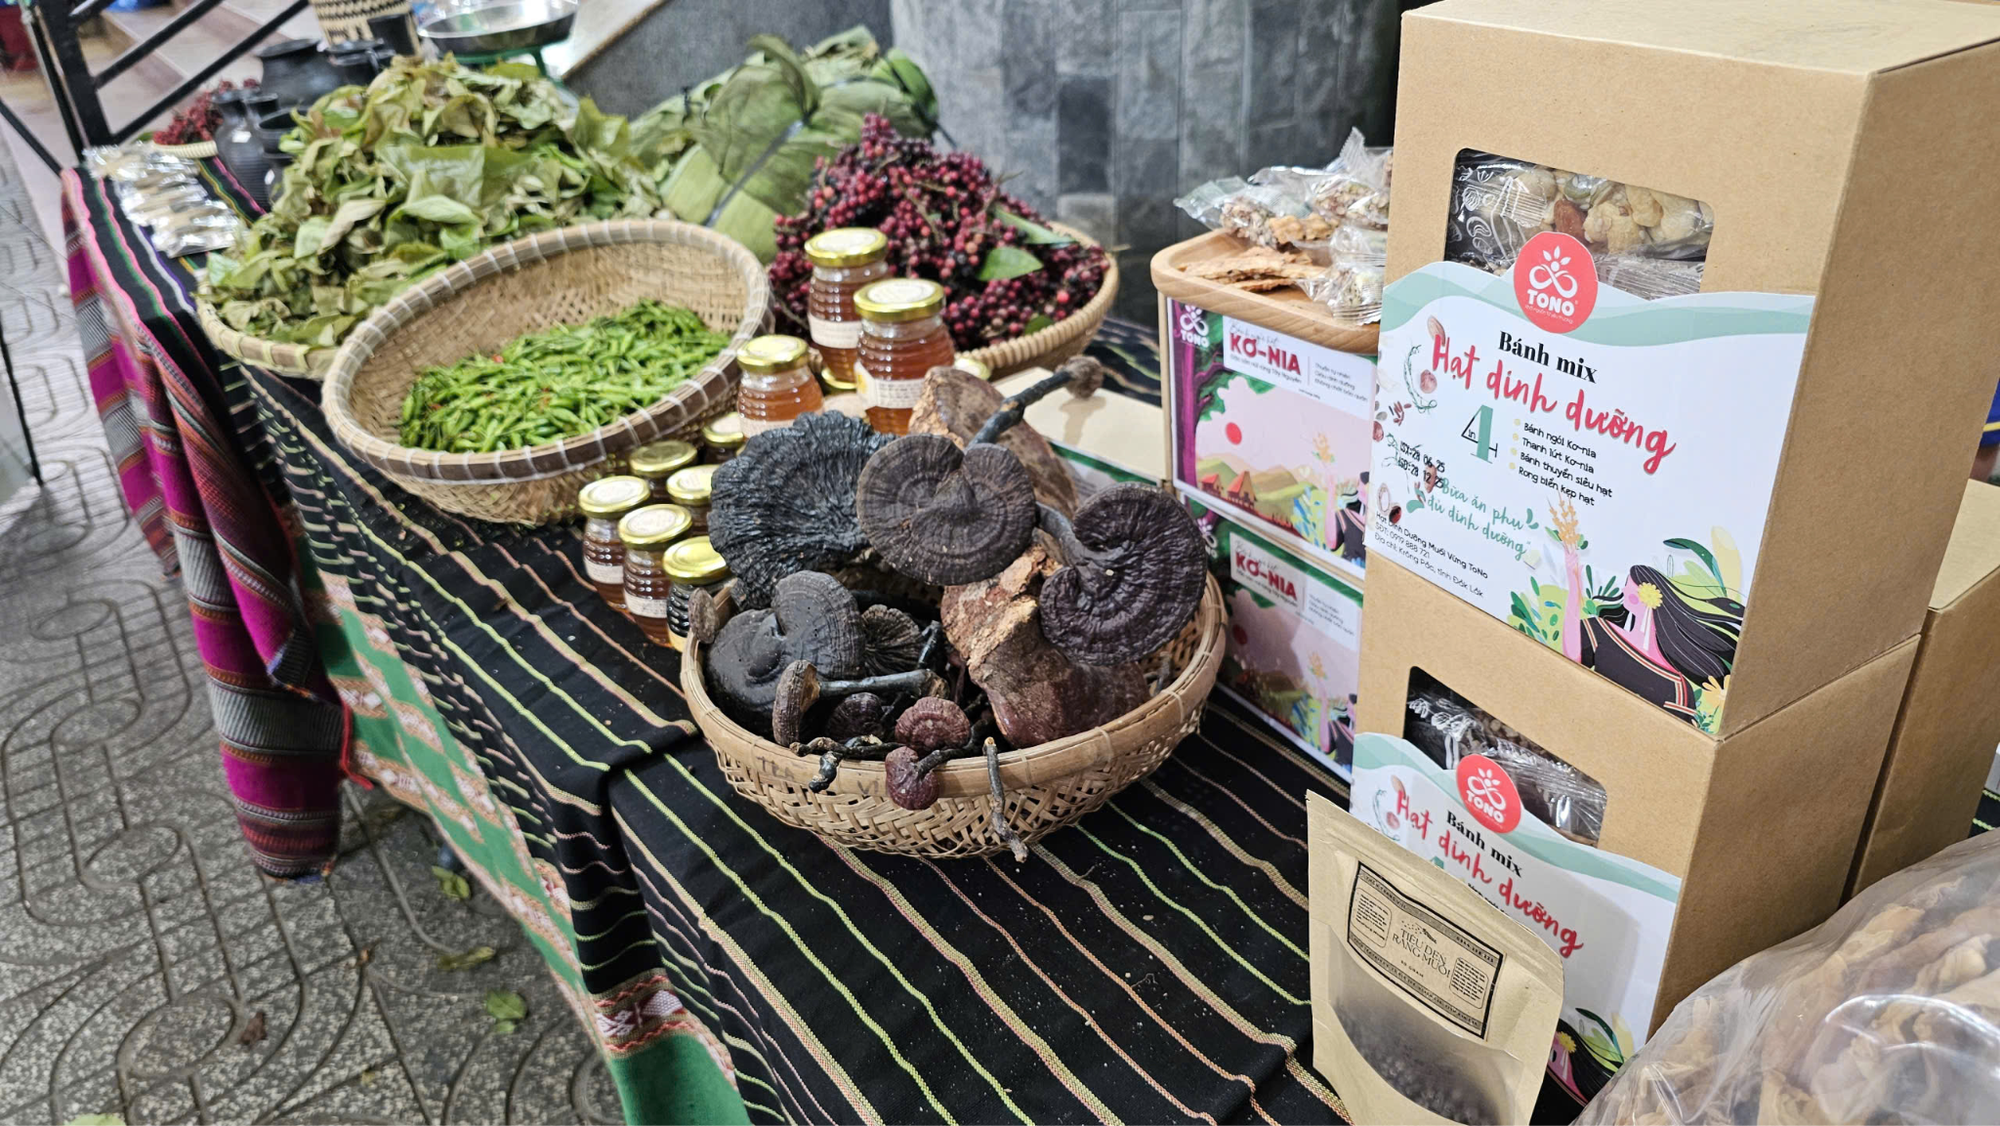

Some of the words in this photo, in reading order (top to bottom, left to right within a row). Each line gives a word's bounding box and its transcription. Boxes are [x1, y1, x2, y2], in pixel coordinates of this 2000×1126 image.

[1527, 289, 1575, 317] TONO
[1181, 330, 1209, 348] TONO
[1498, 330, 1550, 366] Bánh
[1557, 356, 1598, 384] mix
[1432, 334, 1480, 389] Hạt
[1486, 359, 1557, 412] dinh
[1566, 389, 1676, 474] dưỡng
[1522, 437, 1547, 455] Thanh
[1524, 422, 1544, 438] Bánh
[1518, 466, 1539, 484] Rong
[1578, 492, 1595, 506] hạt
[1520, 452, 1540, 467] Bánh
[1596, 484, 1613, 498] hạt
[1448, 505, 1479, 530] dinh
[1472, 494, 1486, 513] ăn
[1492, 507, 1524, 530] phụ
[1466, 790, 1505, 824] TONO
[1446, 809, 1485, 851] Bánh
[1490, 848, 1523, 878] mix
[1396, 789, 1433, 841] Hạt
[1438, 830, 1492, 884] dinh
[1499, 877, 1584, 958] dưỡng
